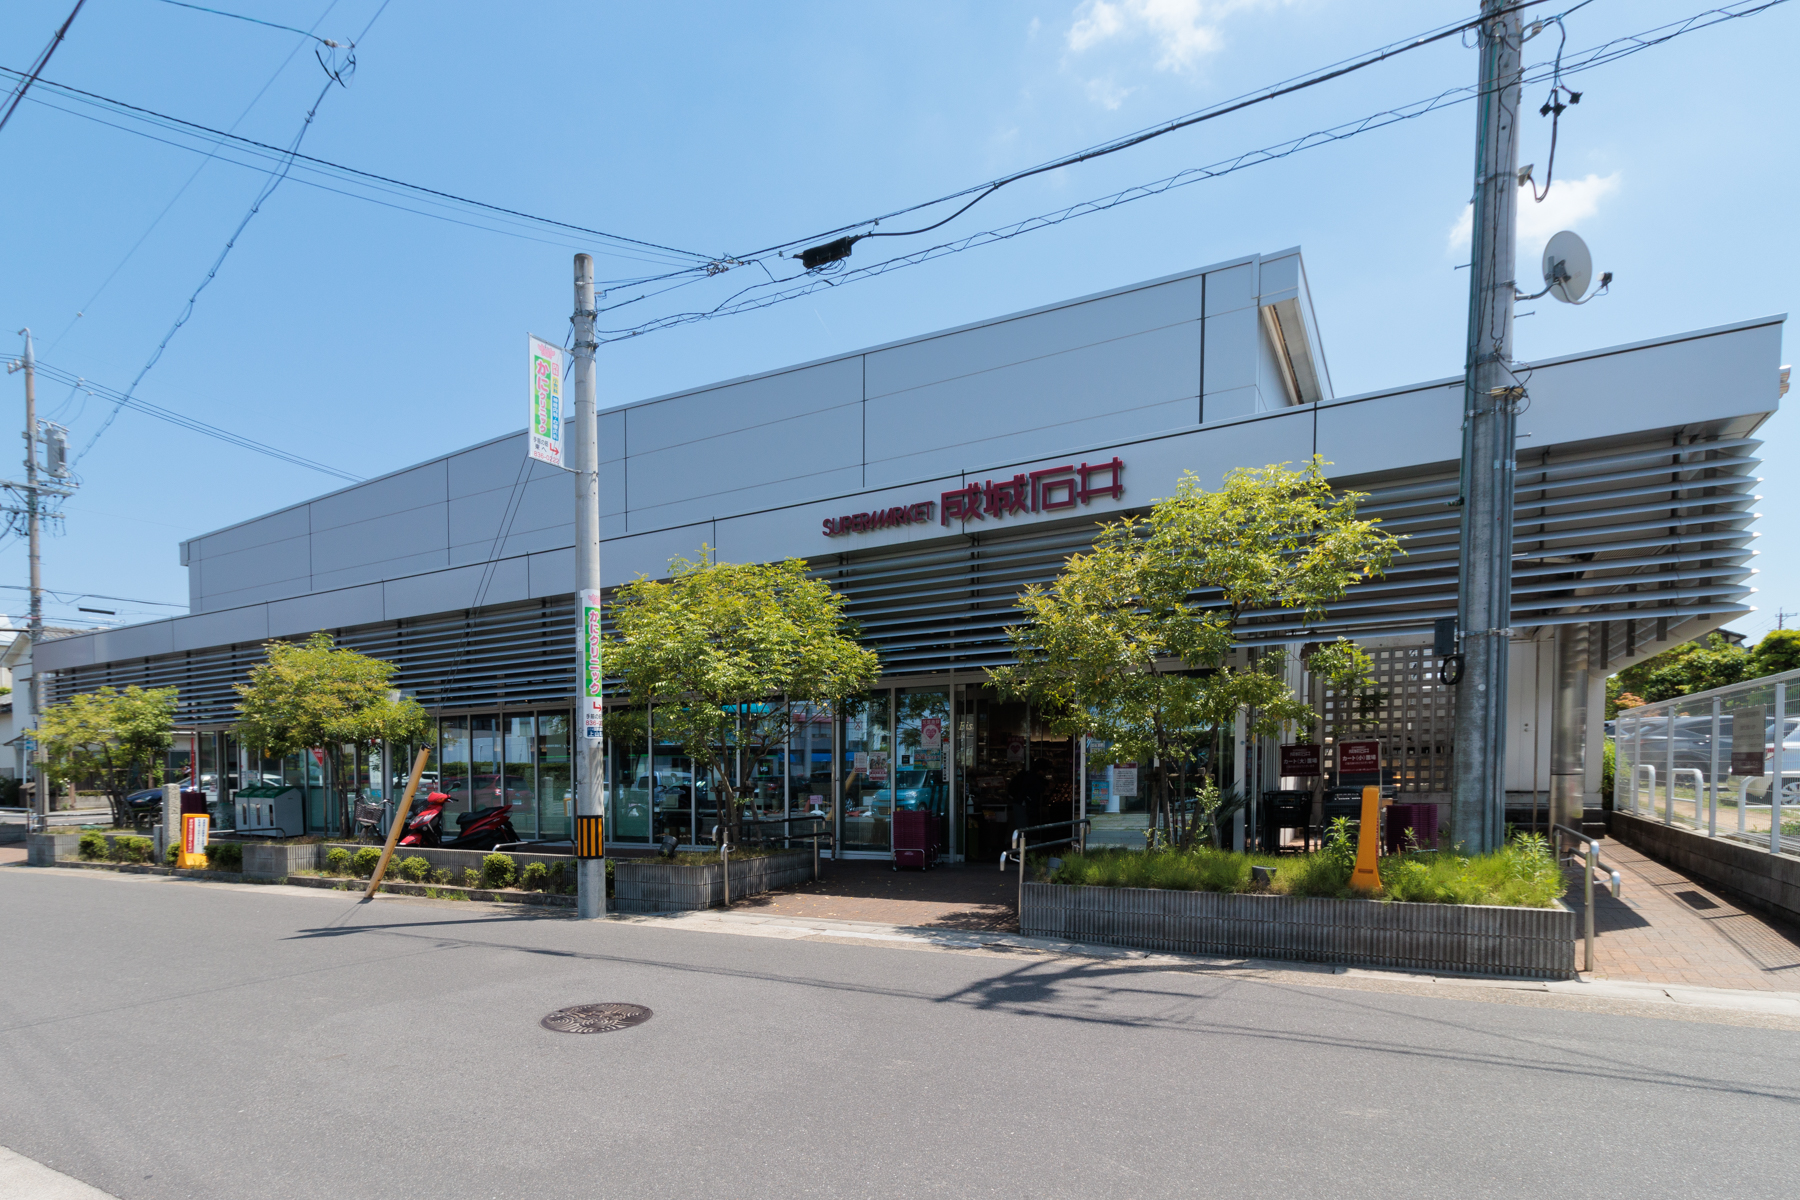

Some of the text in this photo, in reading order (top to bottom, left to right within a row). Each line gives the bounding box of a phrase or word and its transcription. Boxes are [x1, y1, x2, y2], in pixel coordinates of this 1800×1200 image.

[536, 359, 551, 435] かにクリニック
[533, 450, 560, 464] 836-0222
[940, 456, 1124, 527] 成城石井
[822, 500, 934, 537] SUPERMARKET
[589, 609, 601, 696] かにクリニック
